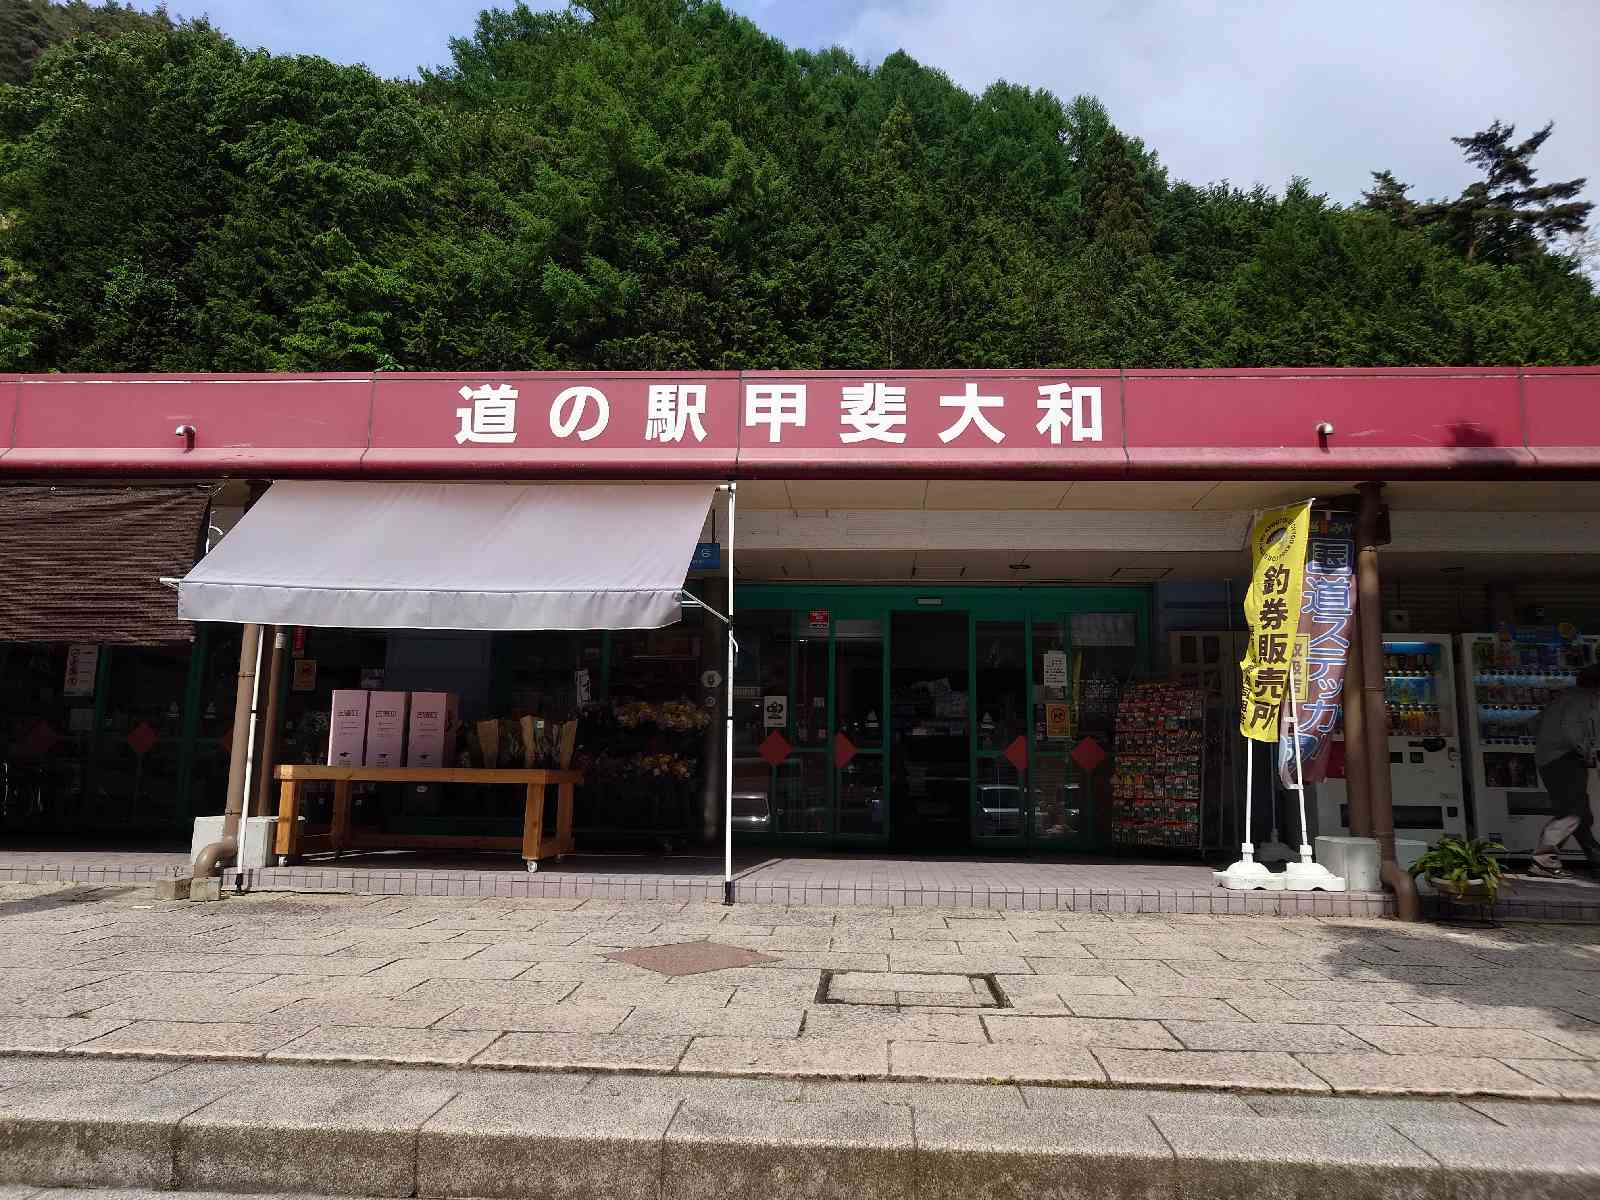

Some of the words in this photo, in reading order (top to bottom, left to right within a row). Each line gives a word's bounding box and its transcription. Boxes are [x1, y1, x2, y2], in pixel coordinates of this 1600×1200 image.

[455, 382, 1104, 444] 道の駅甲斐大和
[1250, 564, 1290, 732] 釣券販売所
